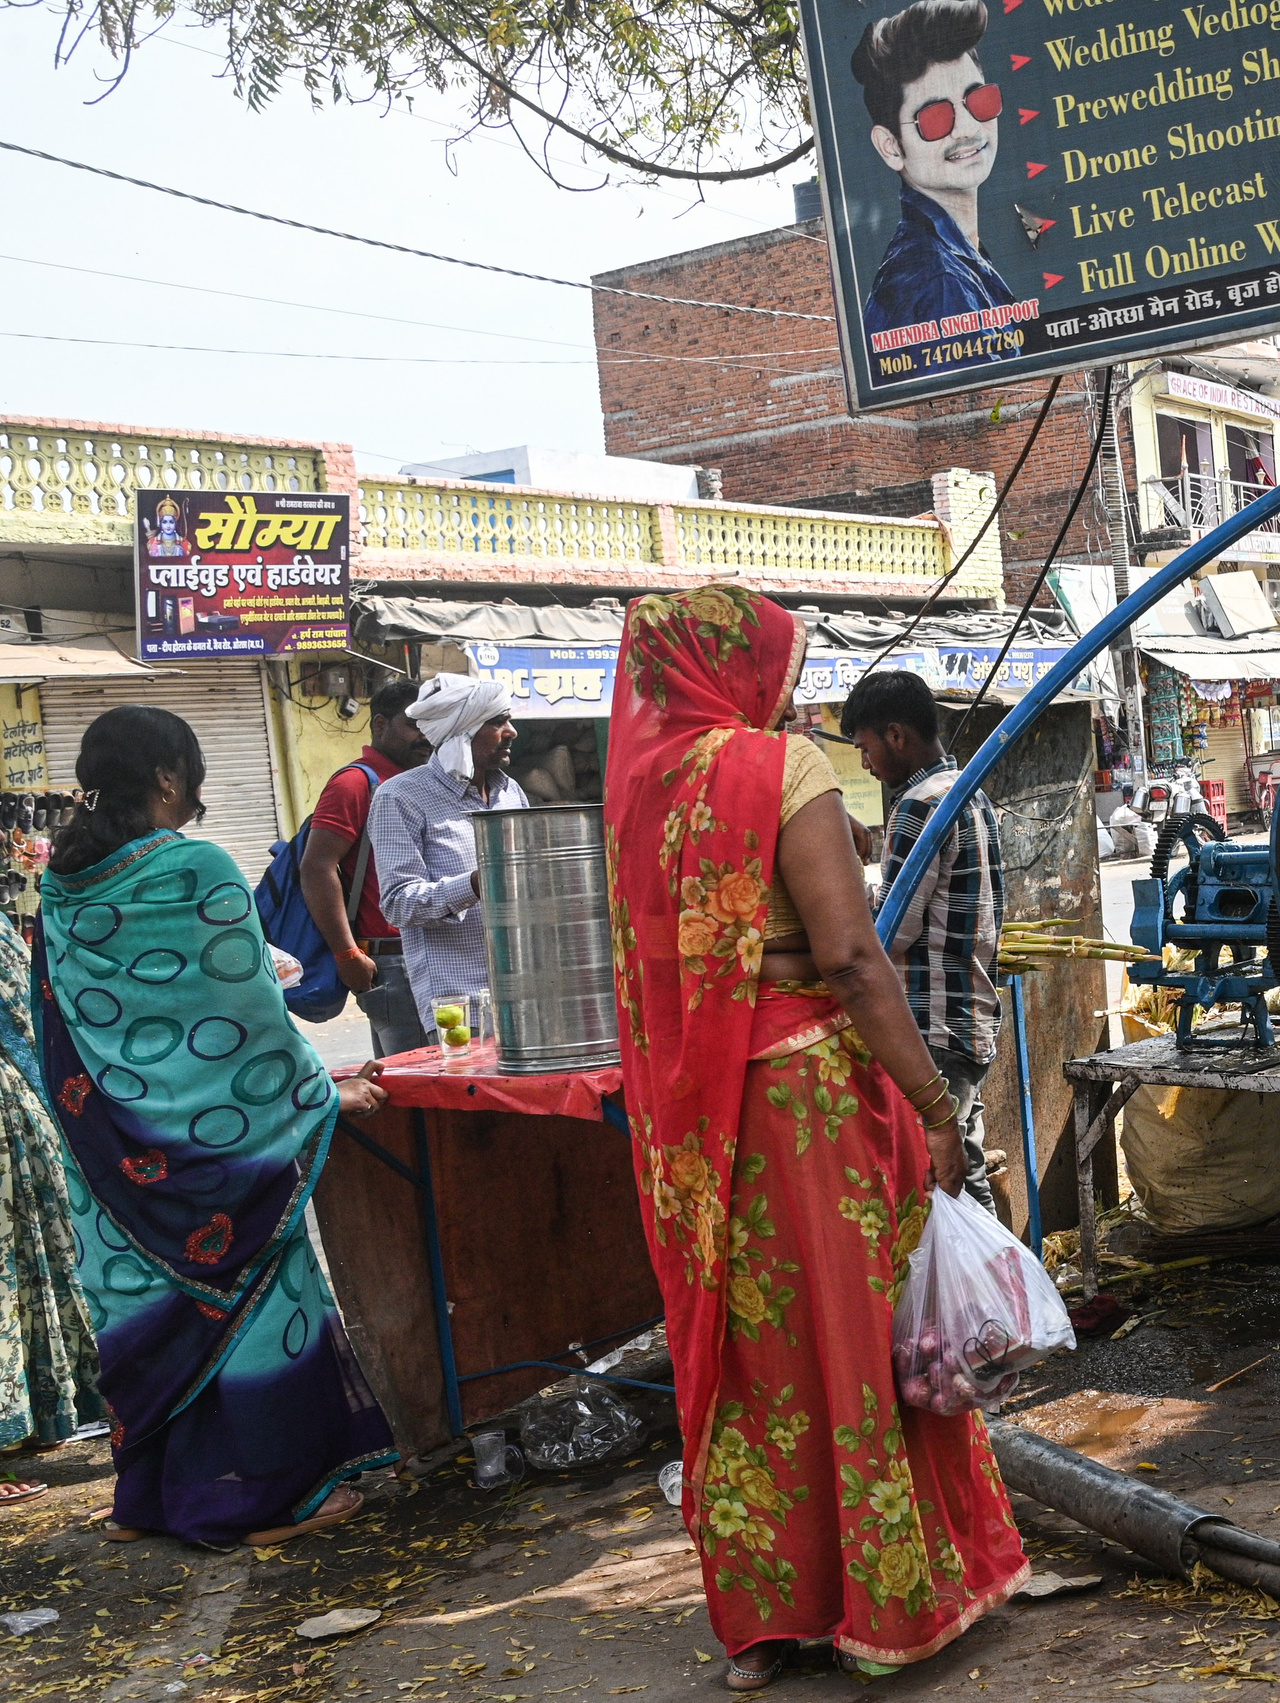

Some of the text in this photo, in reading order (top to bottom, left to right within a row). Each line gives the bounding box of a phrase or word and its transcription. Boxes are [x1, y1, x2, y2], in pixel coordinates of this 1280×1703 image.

[1043, 23, 1175, 73] Wedding
[1052, 66, 1233, 129] Prewedding
[1061, 144, 1158, 184] Drone
[1069, 172, 1268, 239] Live Telecast
[1077, 252, 1137, 293] Full
[1145, 237, 1247, 279] Online
[1148, 294, 1180, 318] मैन
[1227, 279, 1260, 307] बृज
[871, 299, 1039, 353] MAHENDRA SINGH RAJPOOT
[879, 329, 1025, 376] Mob. 7470447780
[1170, 377, 1197, 396] GRACE
[1198, 384, 1208, 398] OF
[1209, 387, 1229, 406] INDIA
[194, 495, 342, 551] सौम्या
[149, 554, 342, 597] प्लाईवुड एवं हार्डवेयर
[1012, 661, 1034, 688] पशु
